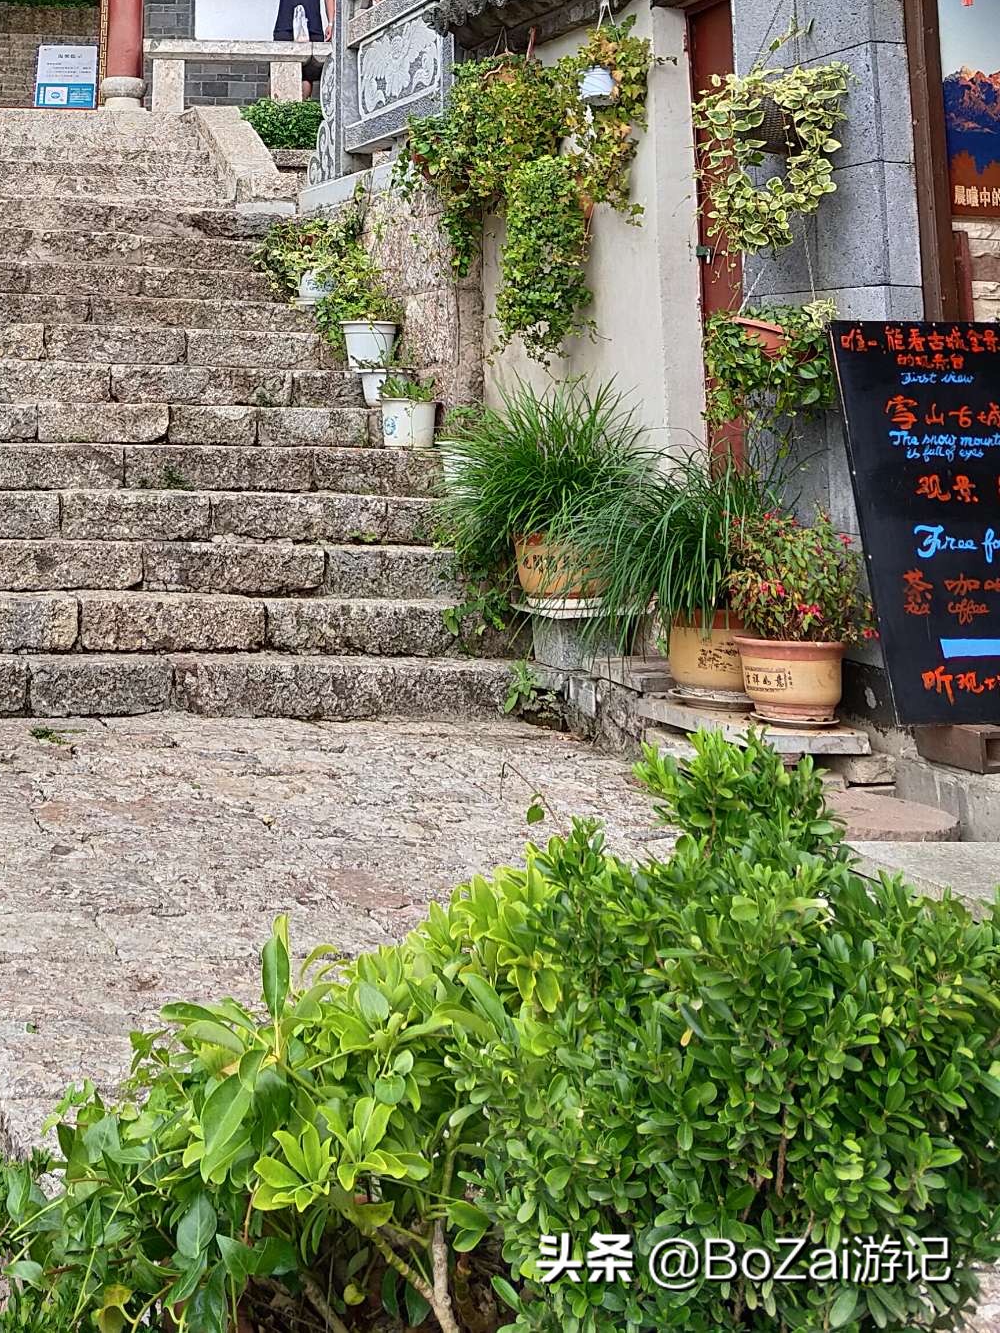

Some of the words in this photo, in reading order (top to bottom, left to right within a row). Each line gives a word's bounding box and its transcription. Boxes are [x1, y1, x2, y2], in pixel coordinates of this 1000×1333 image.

[900, 370, 938, 385] First
[889, 430, 919, 446] The
[921, 433, 957, 446] snow
[914, 525, 979, 558] Free
[947, 597, 990, 626] coffee
